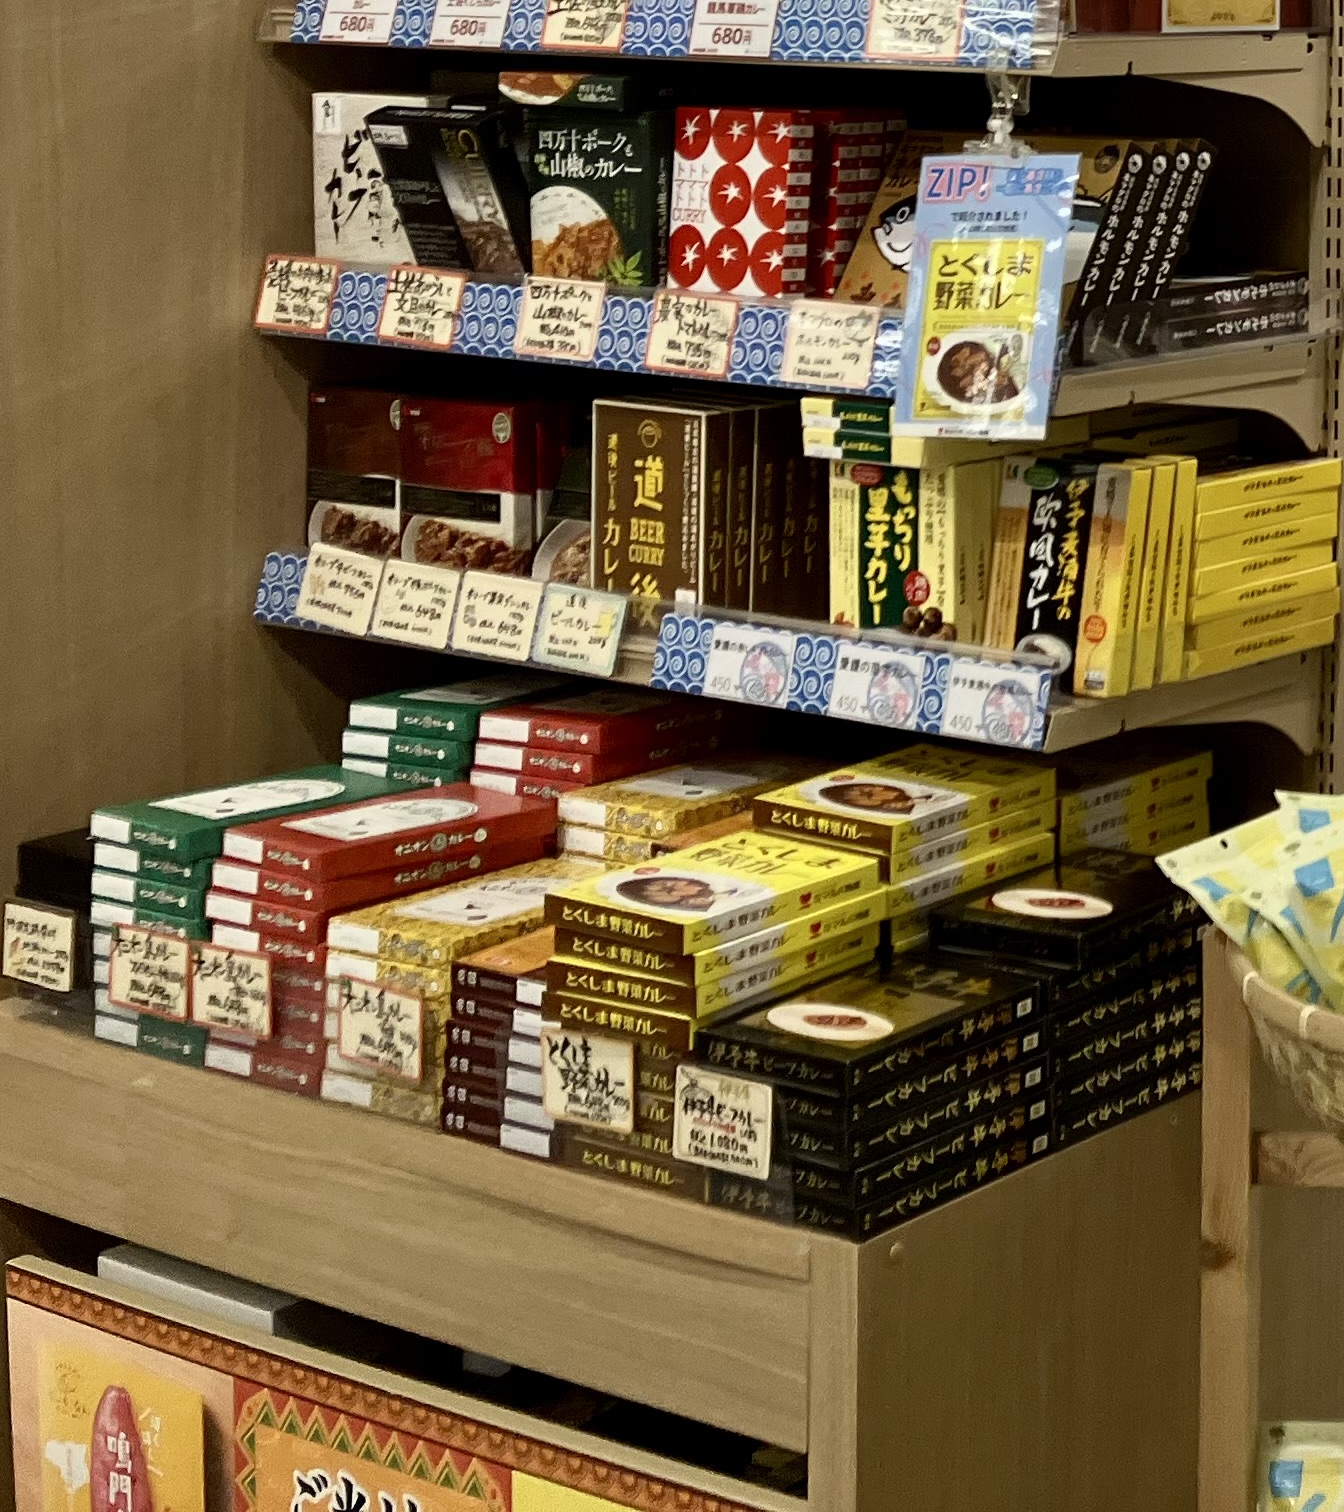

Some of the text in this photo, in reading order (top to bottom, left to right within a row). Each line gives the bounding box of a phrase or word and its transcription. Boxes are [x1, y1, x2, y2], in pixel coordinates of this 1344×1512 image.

[538, 129, 634, 158] 四万十ポークと
[927, 166, 990, 199] ZIP!
[938, 253, 1034, 278] とくしま
[933, 281, 1028, 310] 野菜カレー
[629, 516, 665, 544] BEER
[892, 470, 917, 572] もっちり
[628, 544, 665, 567] CURRY
[864, 488, 891, 626] 里芋カレー
[1025, 494, 1062, 631] 欧風カレー
[770, 809, 872, 841] とくしま野菜カレー
[562, 905, 664, 939] とくしま野菜カレー
[572, 937, 676, 970] とくしま野菜カレー
[565, 970, 676, 1003] とくしま野菜カレー
[560, 1003, 667, 1035] とくしま野菜カレー
[707, 1041, 833, 1080] 伊予牛ビーフカレー
